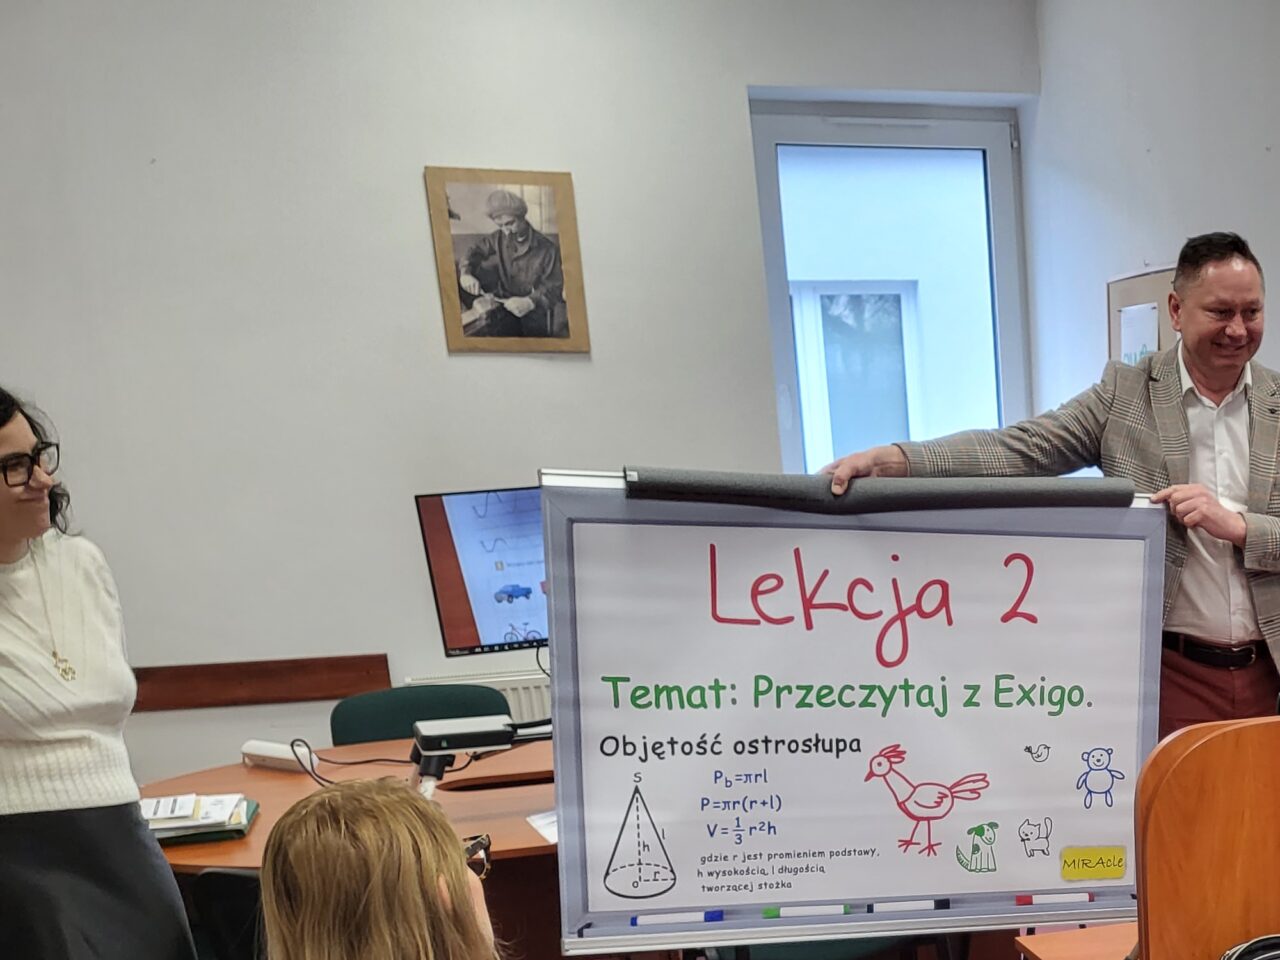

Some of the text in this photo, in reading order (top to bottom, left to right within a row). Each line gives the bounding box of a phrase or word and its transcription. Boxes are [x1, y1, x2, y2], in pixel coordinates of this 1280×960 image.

[709, 543, 1038, 668] Lekcja 2
[601, 674, 1093, 718] Temat: Przeczytaj z Exigo.
[600, 732, 862, 763] Objętość ostrosłupa
[700, 853, 729, 866] gdzie
[732, 853, 738, 862] r
[741, 851, 764, 864] jest
[767, 849, 826, 862] promieniem
[697, 868, 704, 878] h
[778, 862, 826, 877] długością
[701, 879, 793, 893] tworzącej stożka
